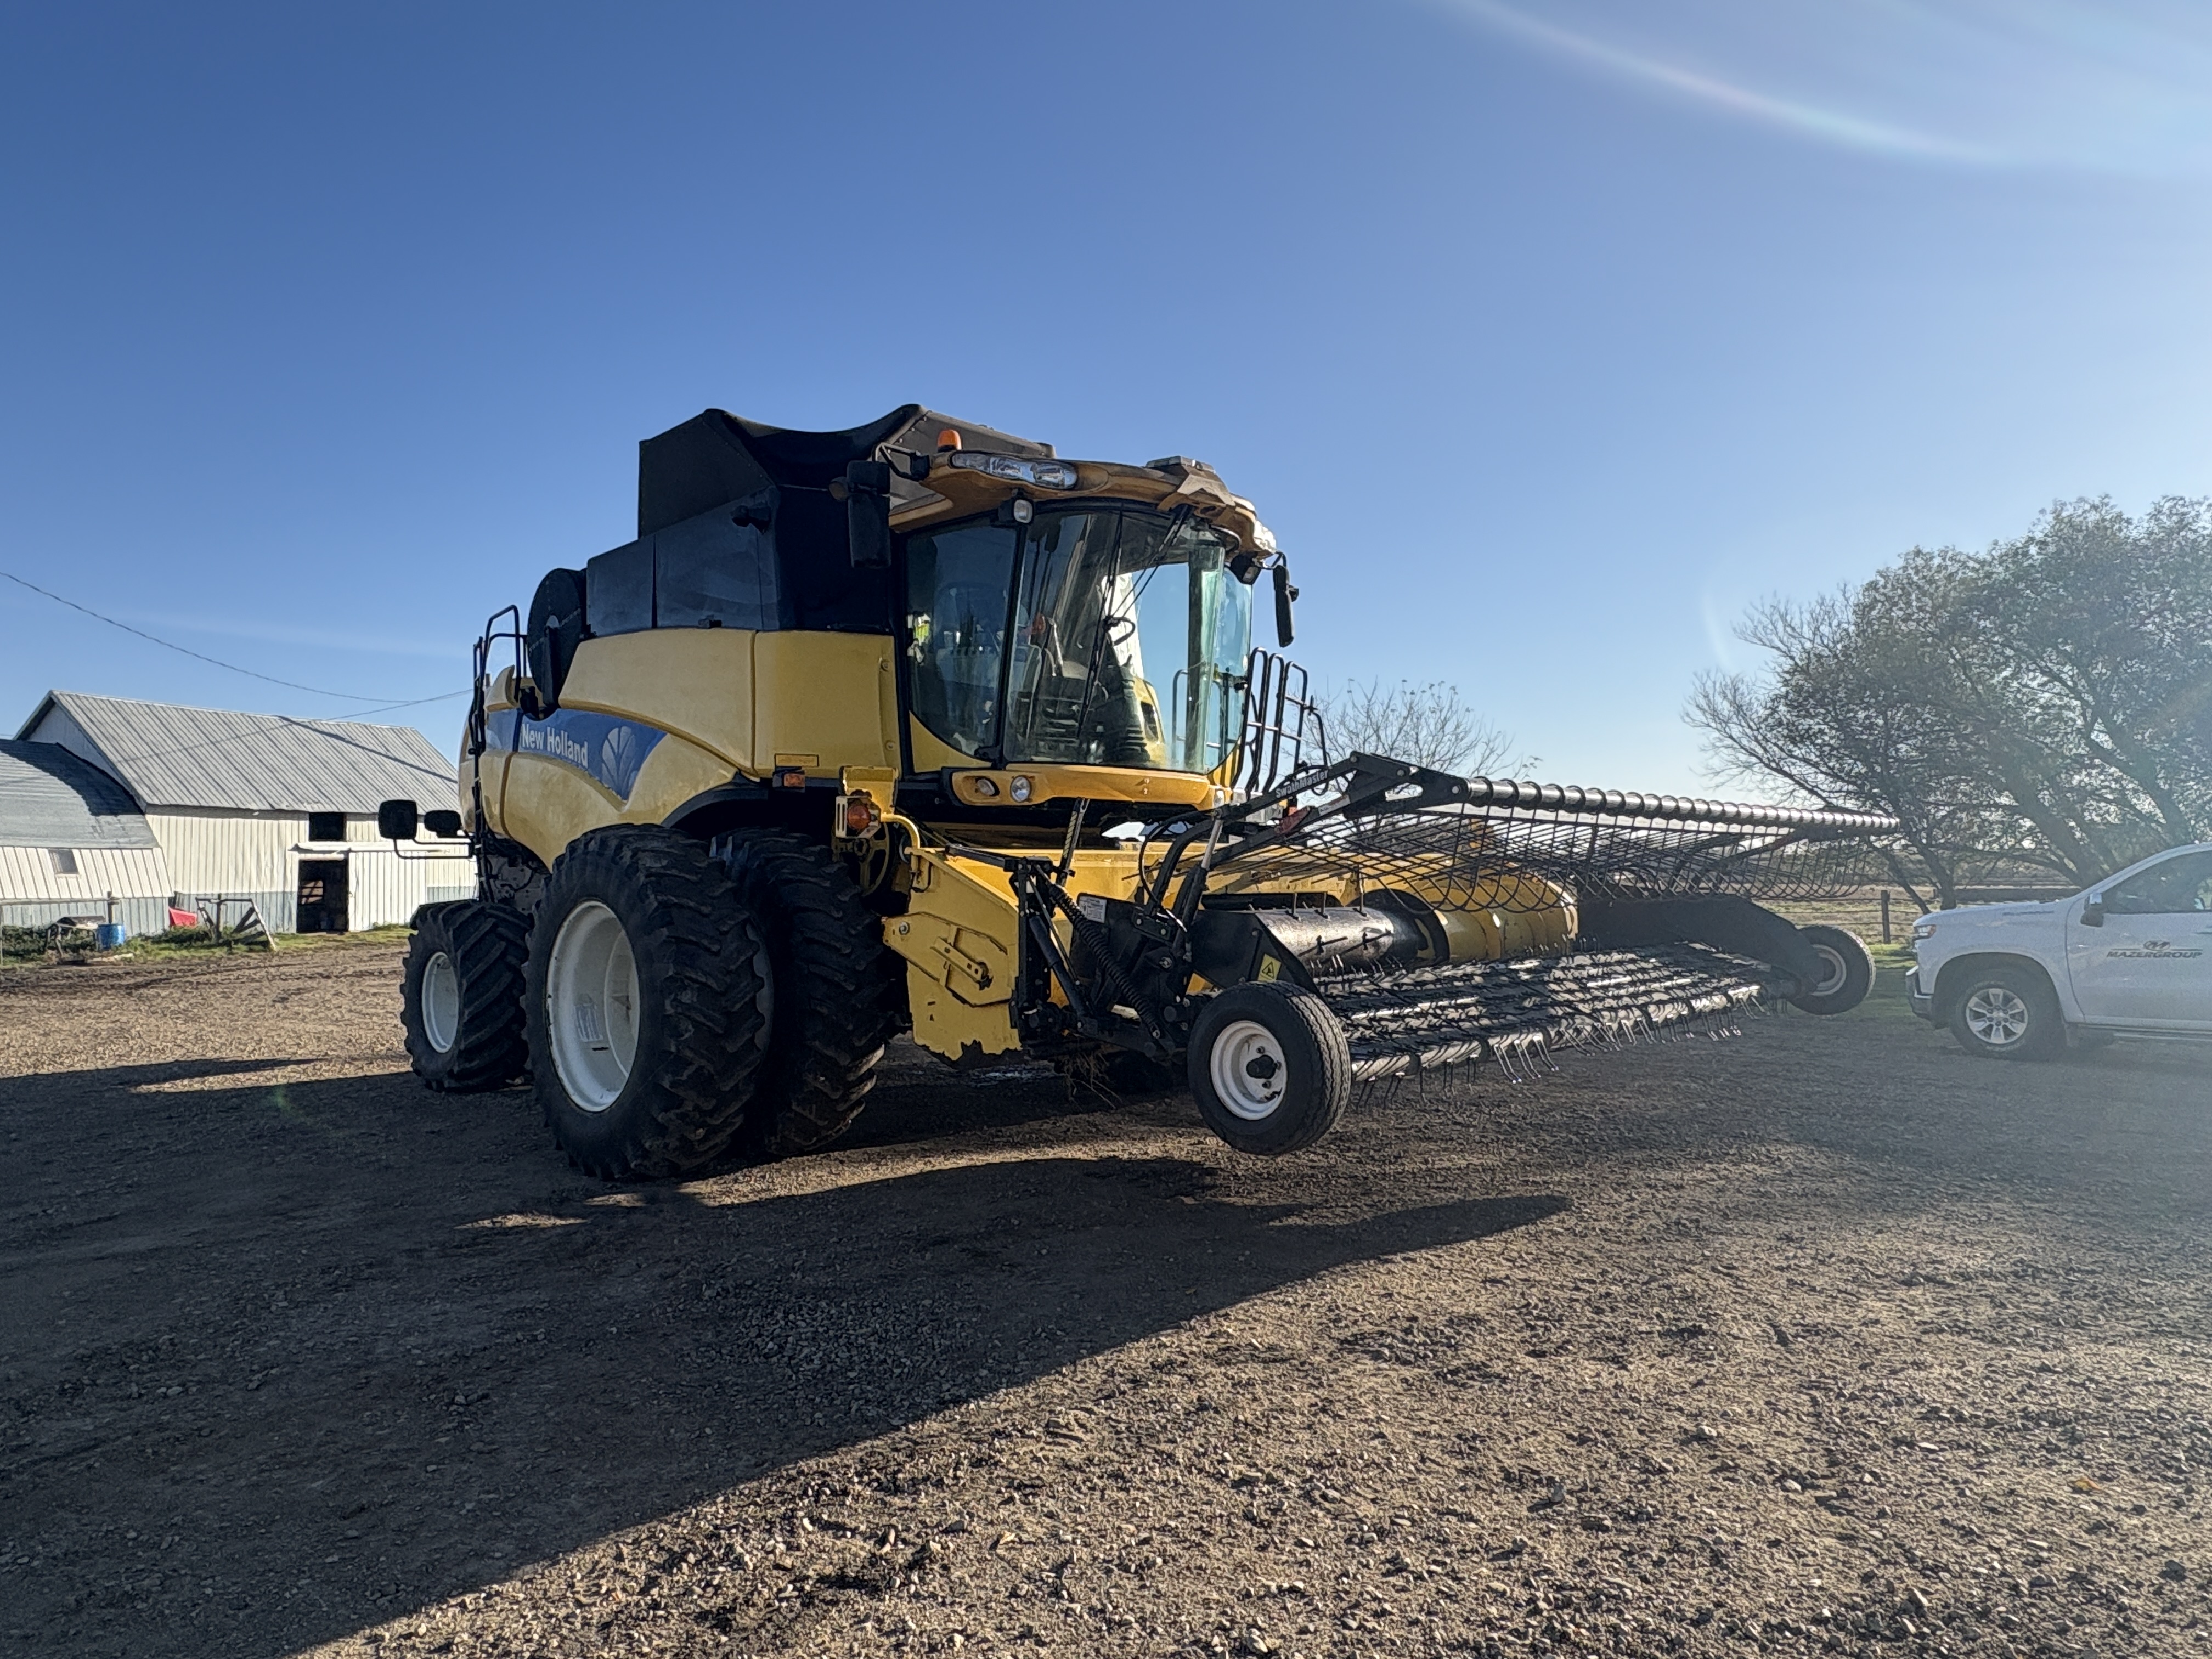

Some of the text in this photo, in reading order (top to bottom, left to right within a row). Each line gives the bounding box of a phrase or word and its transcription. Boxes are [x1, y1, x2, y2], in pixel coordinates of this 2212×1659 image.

[522, 723, 588, 768] New Holland
[1275, 770, 1328, 798] SwathMaster
